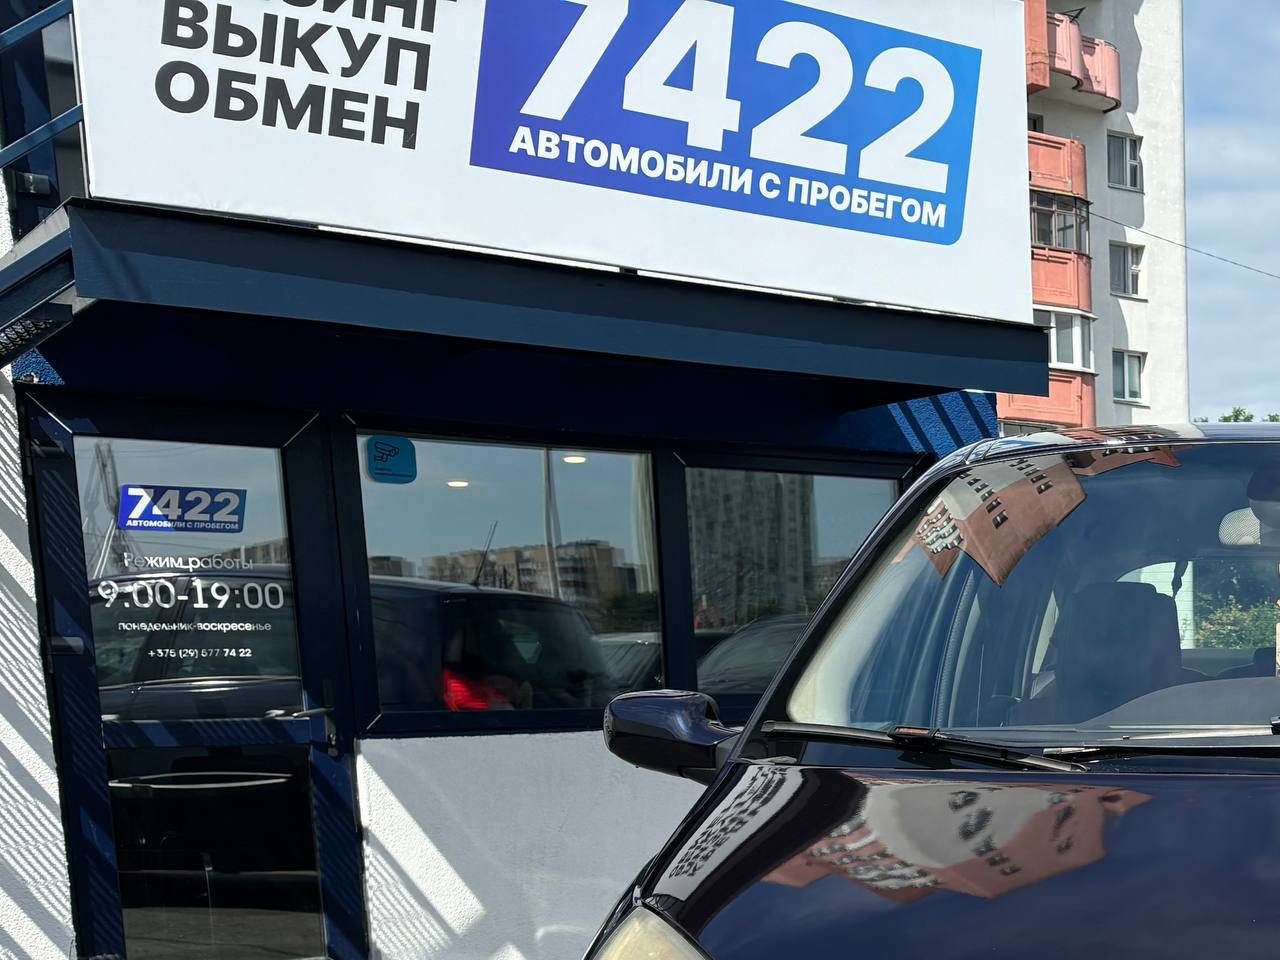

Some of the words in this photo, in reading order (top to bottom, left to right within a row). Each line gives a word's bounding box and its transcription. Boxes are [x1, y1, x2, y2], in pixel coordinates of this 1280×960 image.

[160, 0, 431, 92] ВЫКУП
[154, 60, 420, 151] ОБМЕН
[519, 0, 955, 194] 7422
[508, 125, 753, 195] АВТОМОБИЛИ
[758, 172, 782, 199] С
[787, 176, 947, 229] ПРОБЕГОМ
[125, 519, 186, 529] АВТОМОБИЛИ
[194, 521, 239, 530] ПРОБЕГОМ
[128, 488, 240, 522] 7422
[124, 552, 183, 568] Режим
[188, 553, 253, 573] работы
[148, 648, 176, 658] +375
[179, 648, 198, 659] (29)
[223, 648, 237, 658] 74
[239, 648, 252, 658] 22
